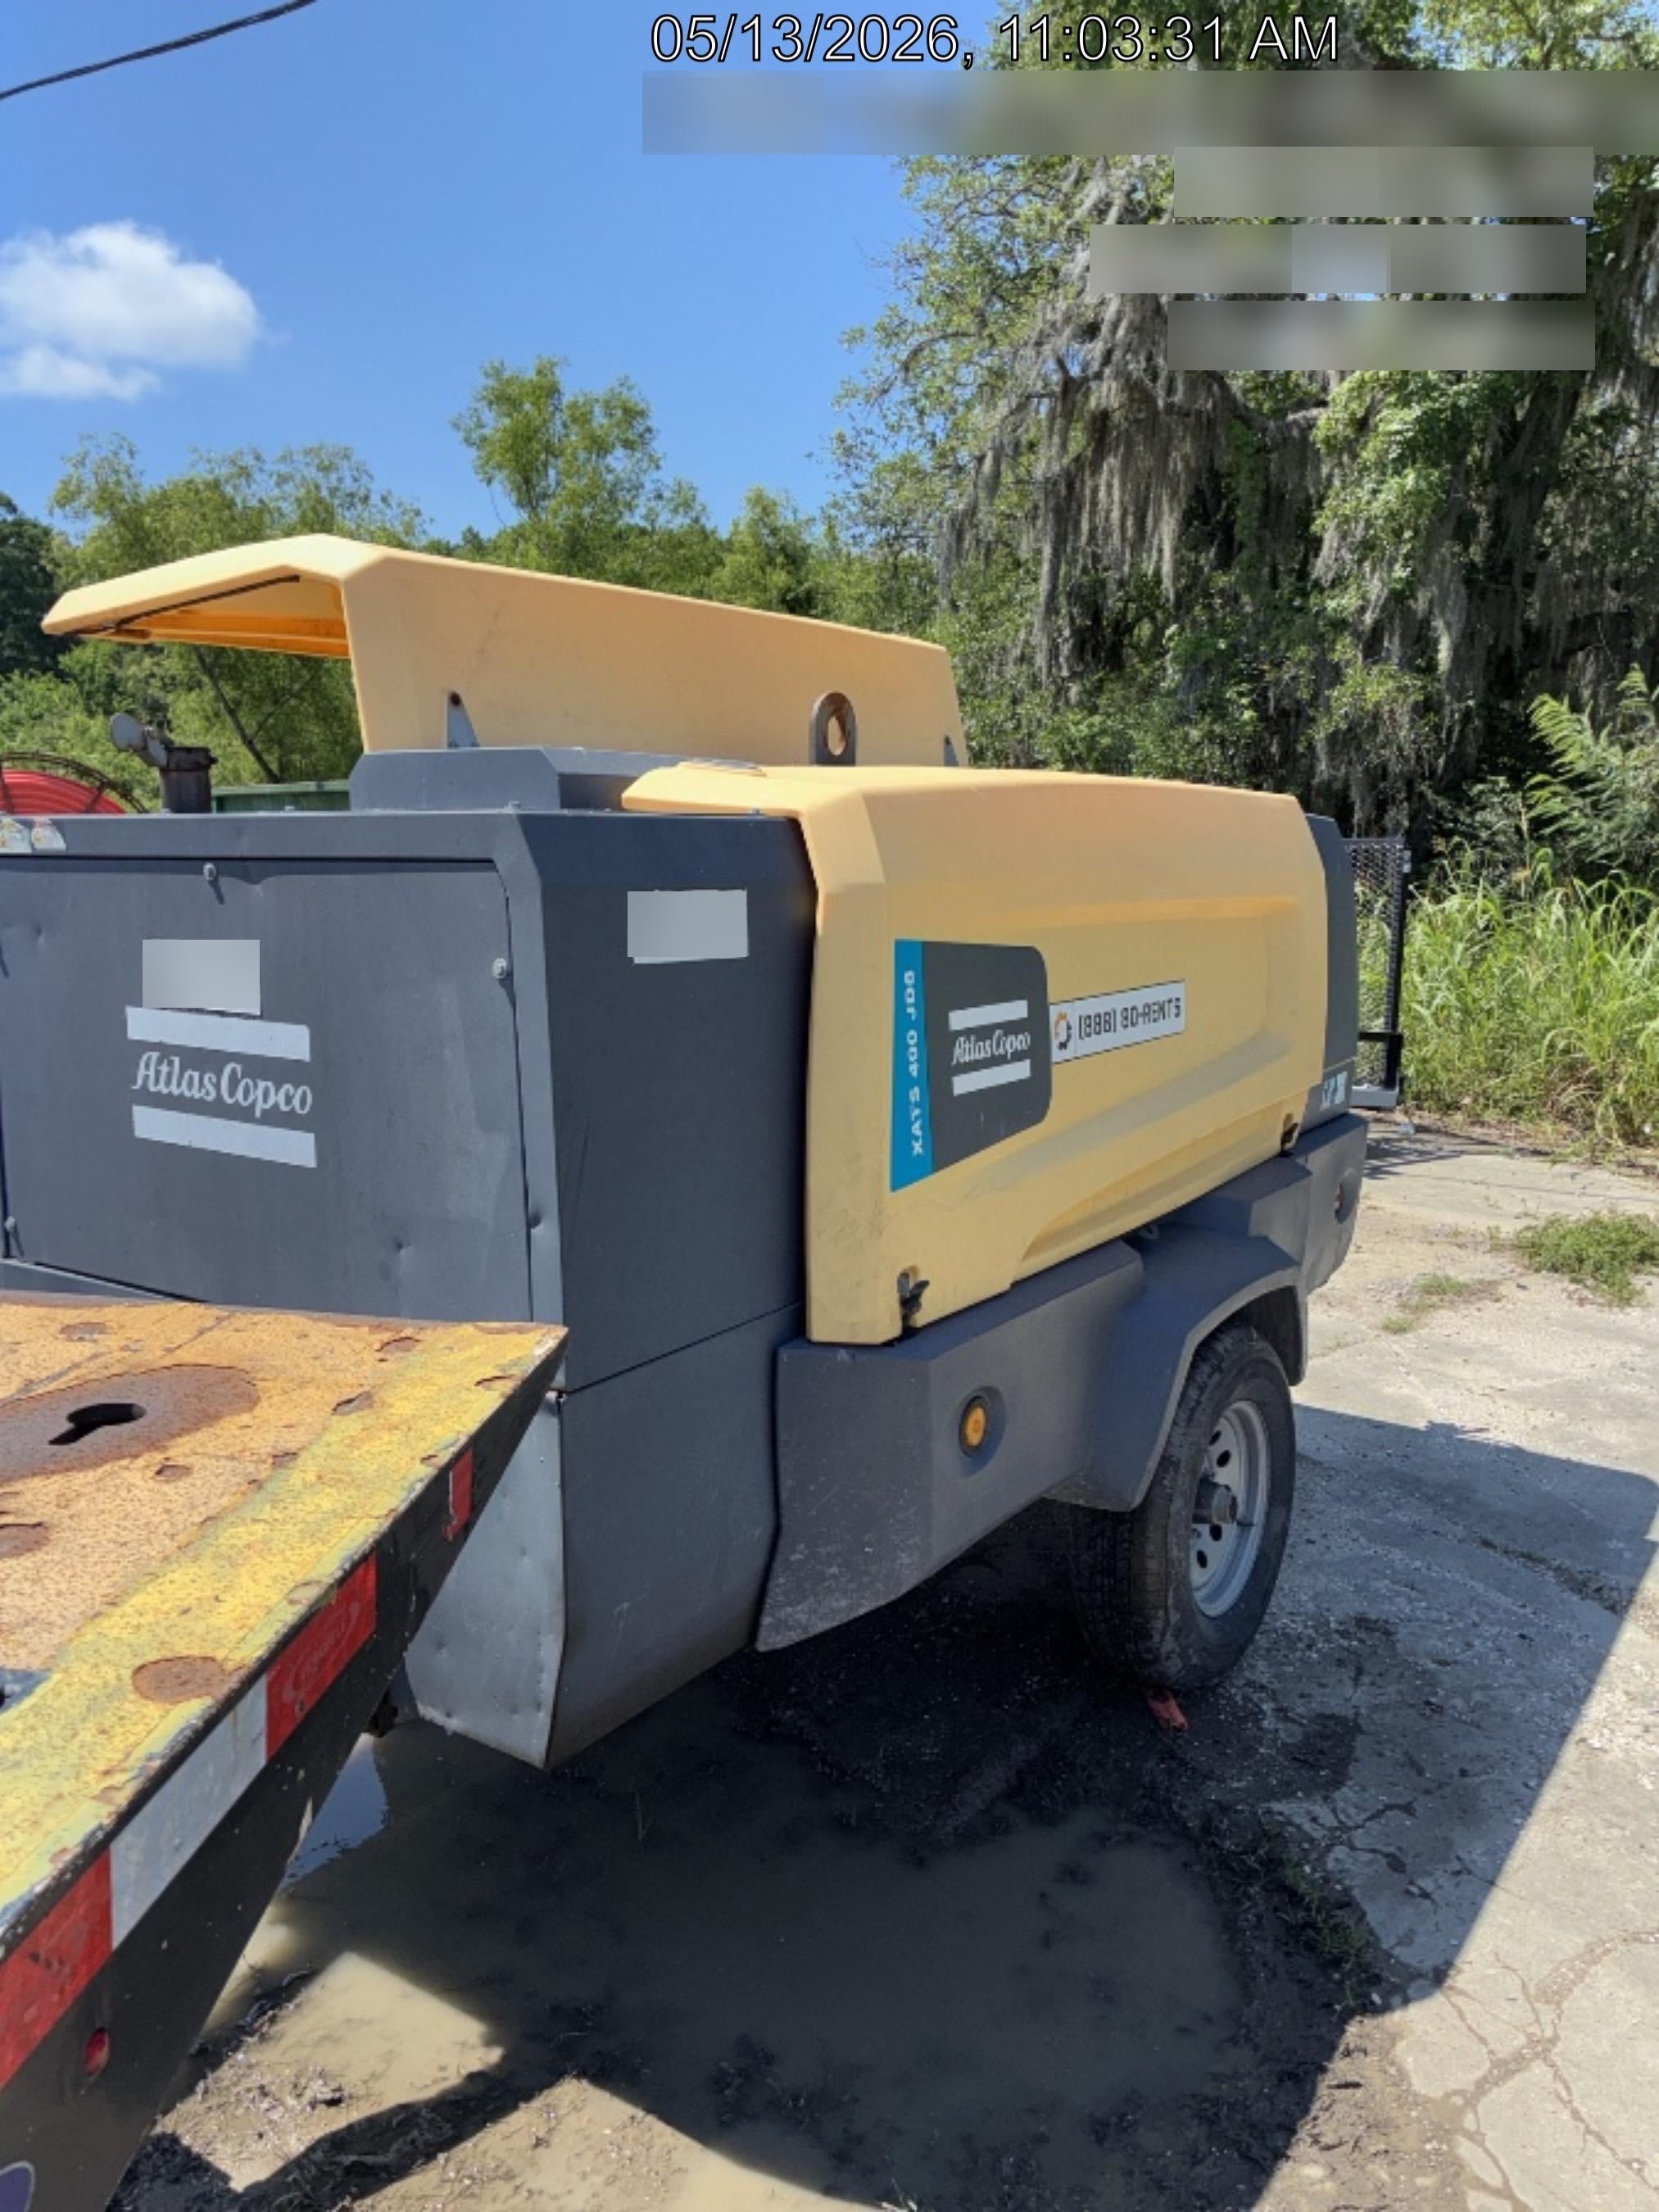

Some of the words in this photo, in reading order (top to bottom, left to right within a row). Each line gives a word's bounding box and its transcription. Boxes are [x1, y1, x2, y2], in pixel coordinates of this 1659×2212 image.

[905, 1029, 919, 1078] 400
[950, 1034, 991, 1067] Atlas
[992, 1028, 1031, 1060] Copco
[130, 1050, 217, 1102] Atlas
[220, 1061, 313, 1119] Copco
[908, 1085, 924, 1158] XATS
